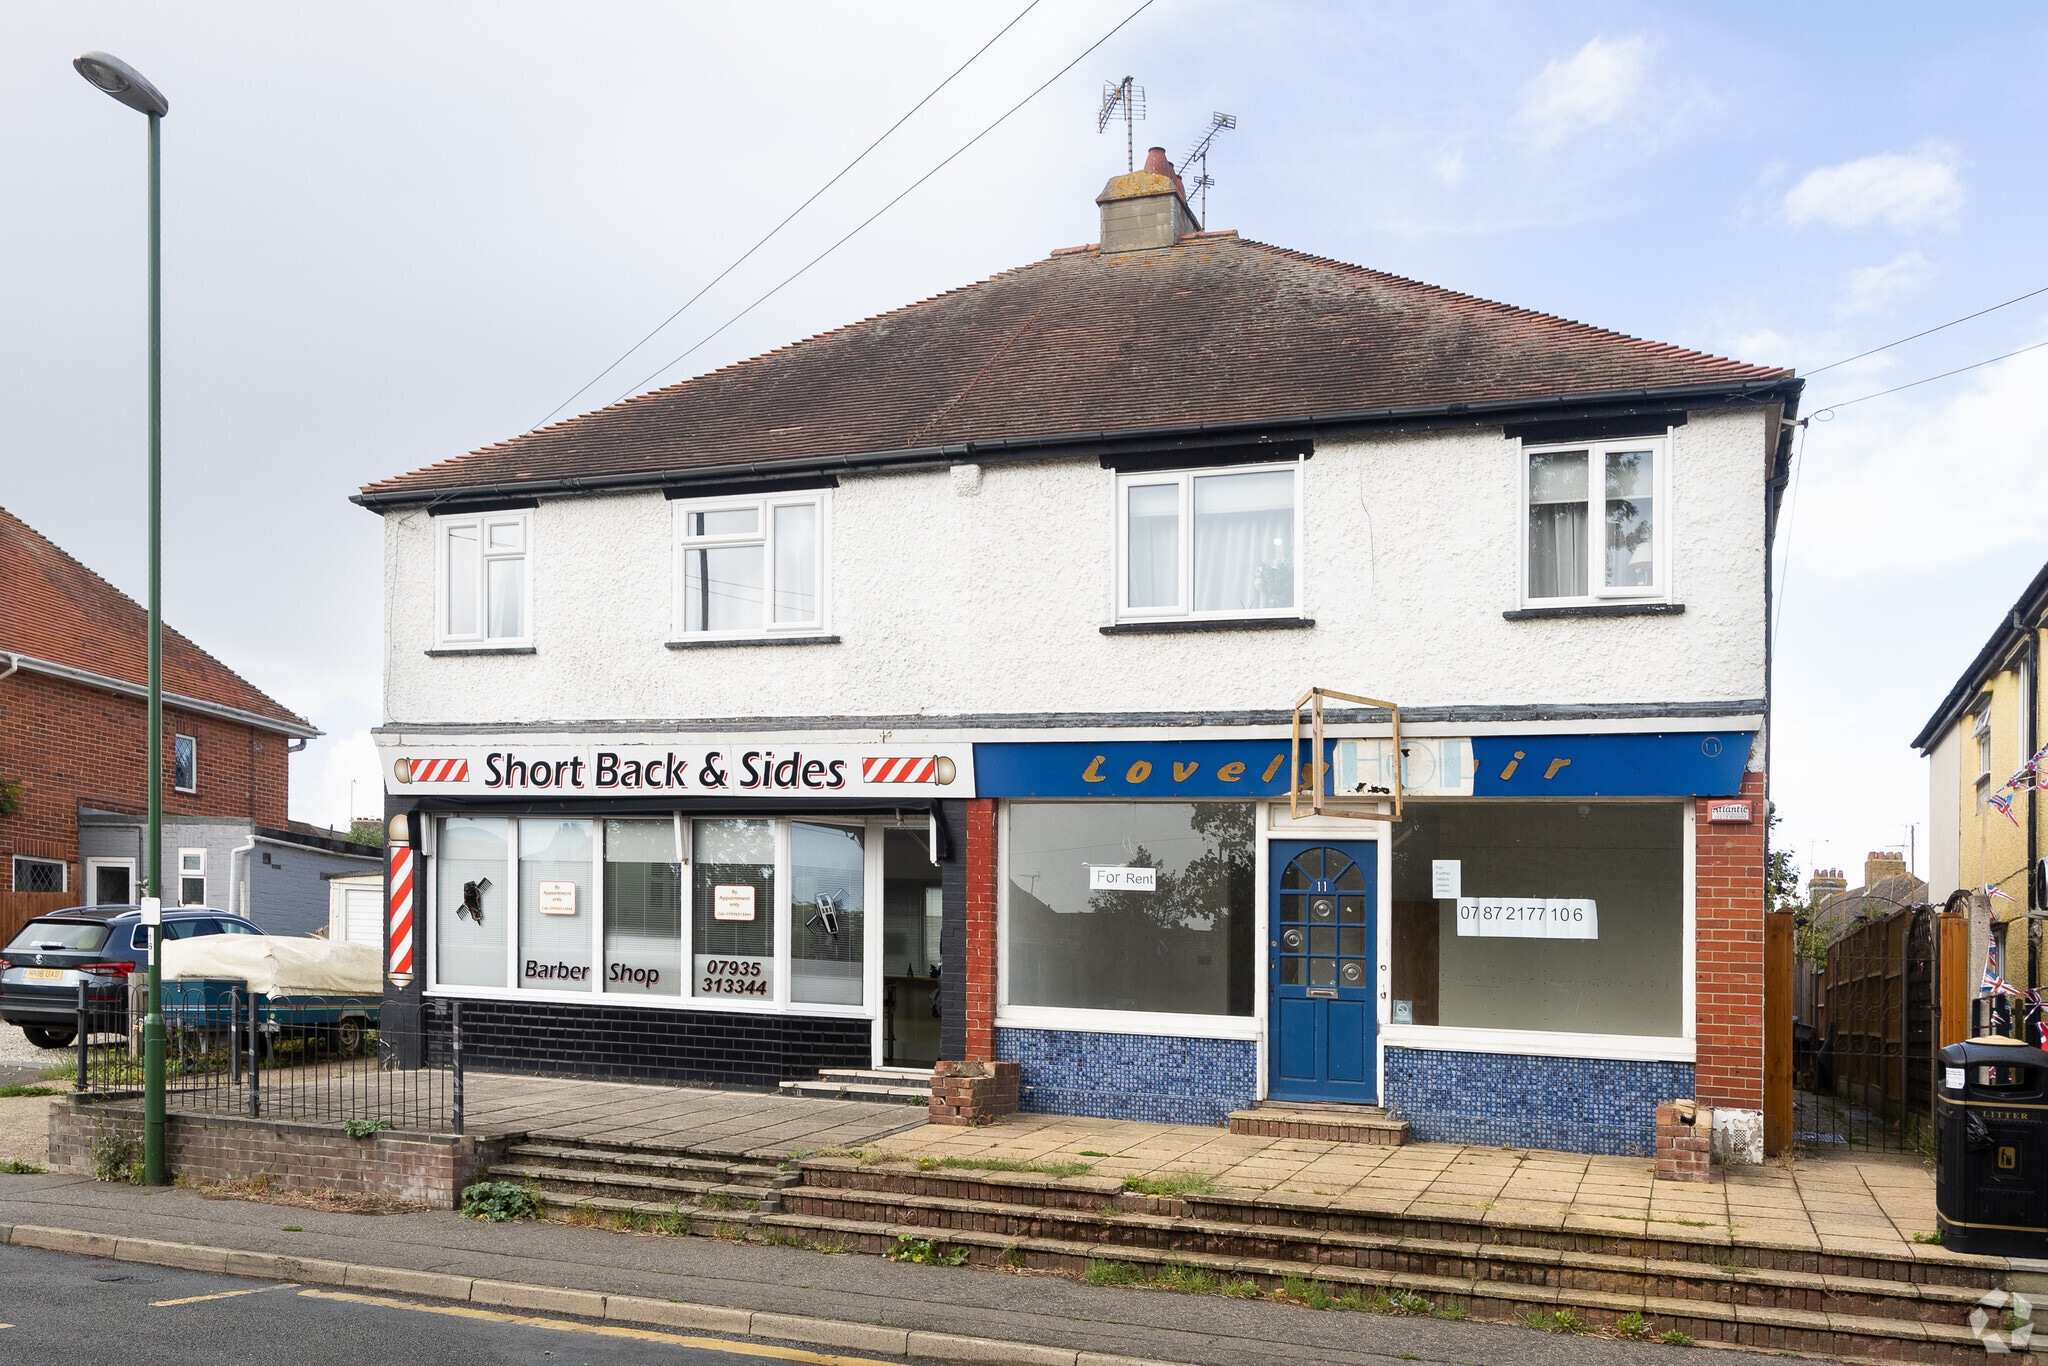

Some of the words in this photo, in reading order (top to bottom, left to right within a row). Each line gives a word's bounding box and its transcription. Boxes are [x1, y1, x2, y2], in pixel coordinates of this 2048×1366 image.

[485, 752, 586, 789] Short
[595, 752, 688, 789] Back
[699, 751, 729, 789] &
[740, 751, 847, 789] Sides
[1712, 804, 1749, 814] Atlantic
[1097, 870, 1120, 883] For
[1126, 873, 1154, 885] Rent
[1317, 881, 1327, 892] 11
[524, 959, 591, 981] Barber
[608, 962, 661, 989] Shop
[706, 959, 762, 977] 07935
[701, 977, 768, 995] 313344
[1983, 1110, 2028, 1120] LITTER
